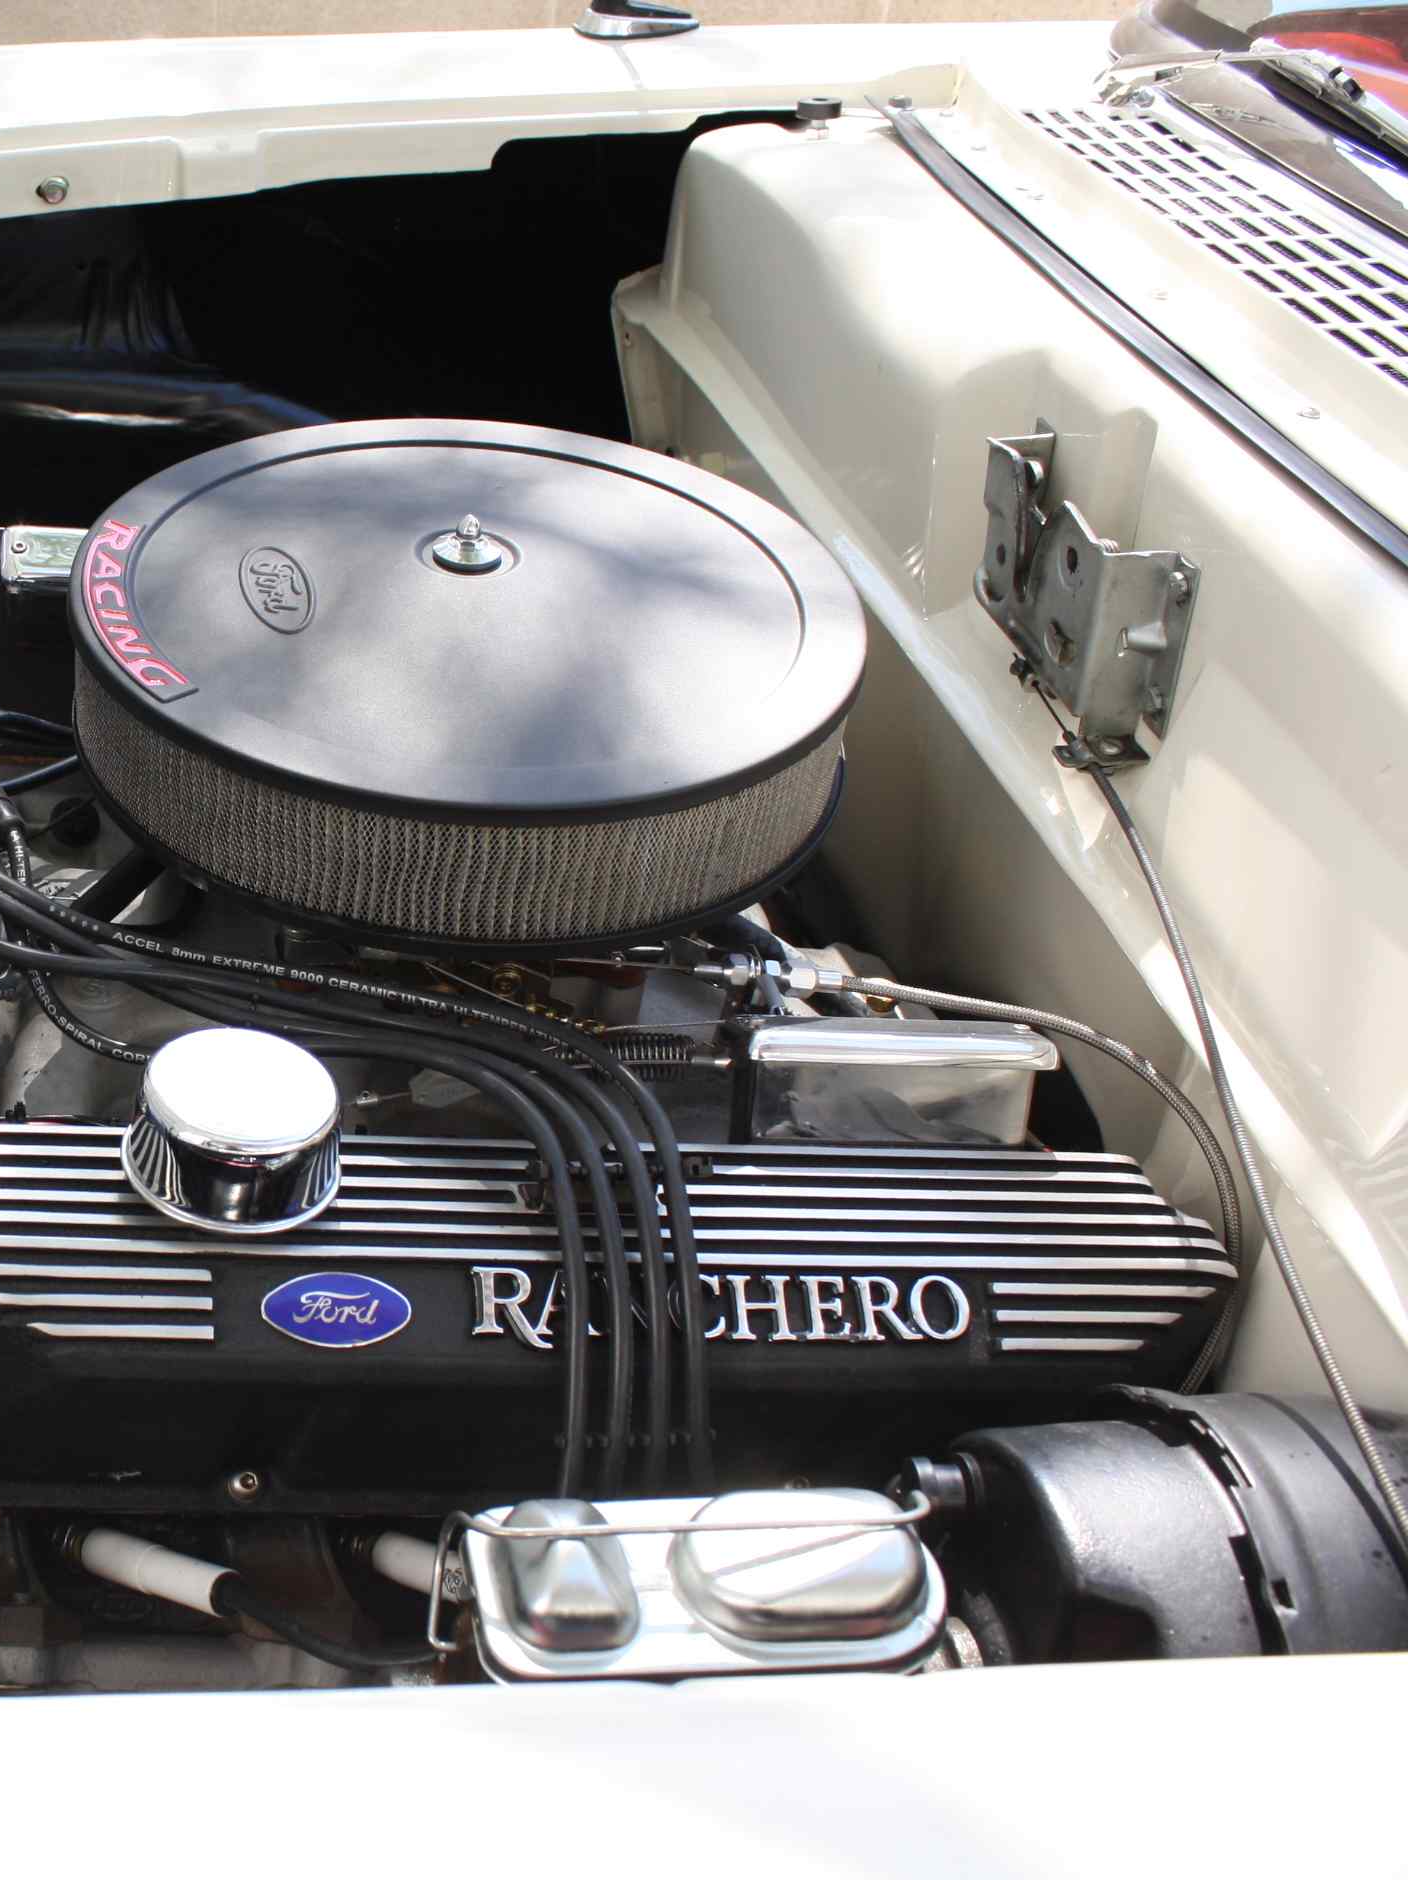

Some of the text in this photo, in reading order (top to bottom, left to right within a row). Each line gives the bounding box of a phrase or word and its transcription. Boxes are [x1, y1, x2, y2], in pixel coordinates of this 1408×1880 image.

[85, 519, 189, 687] RACING
[249, 561, 303, 615] Ford
[111, 931, 164, 954] ACCEL
[170, 946, 207, 963] 8mm
[211, 955, 286, 977] EXTREME
[289, 968, 324, 985] 9000
[328, 976, 397, 1001] CERAMIC
[400, 993, 449, 1014] ULTRA
[30, 968, 153, 1066] FERRO-SPIRAL COR
[291, 1289, 379, 1327] Ford
[470, 1265, 971, 1351] RACHERO
